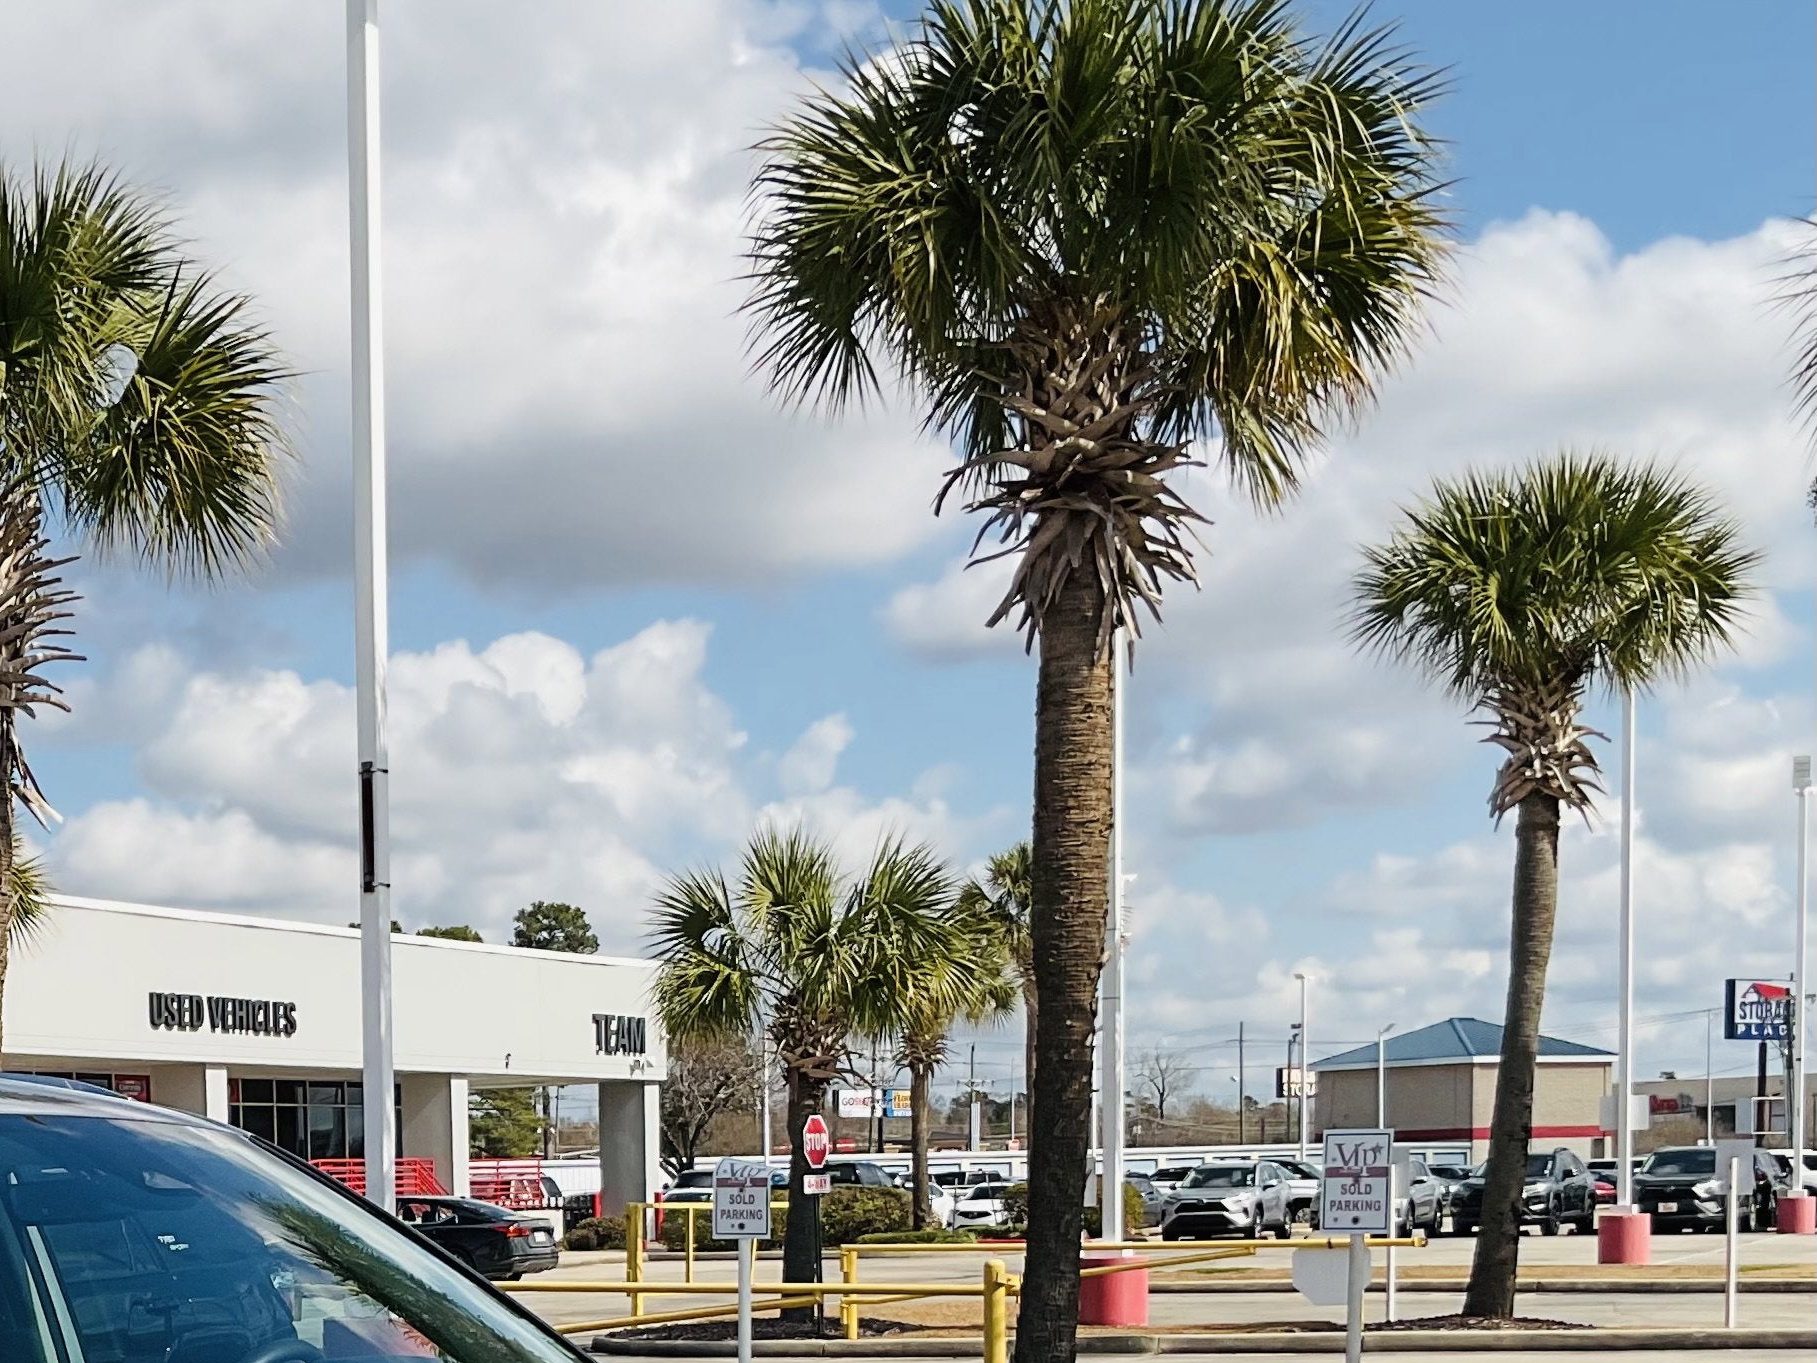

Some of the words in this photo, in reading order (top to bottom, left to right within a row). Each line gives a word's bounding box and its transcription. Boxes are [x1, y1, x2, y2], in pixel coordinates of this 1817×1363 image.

[149, 992, 204, 1030] USED
[207, 996, 297, 1037] VEHICLES
[592, 1013, 646, 1055] TEAM
[1737, 1023, 1795, 1036] PLAC
[806, 1133, 827, 1151] STOP
[1341, 1183, 1372, 1195] SOLD
[729, 1194, 755, 1205] SOLD
[1330, 1200, 1381, 1212] PARKING
[720, 1209, 763, 1220] PARKING
